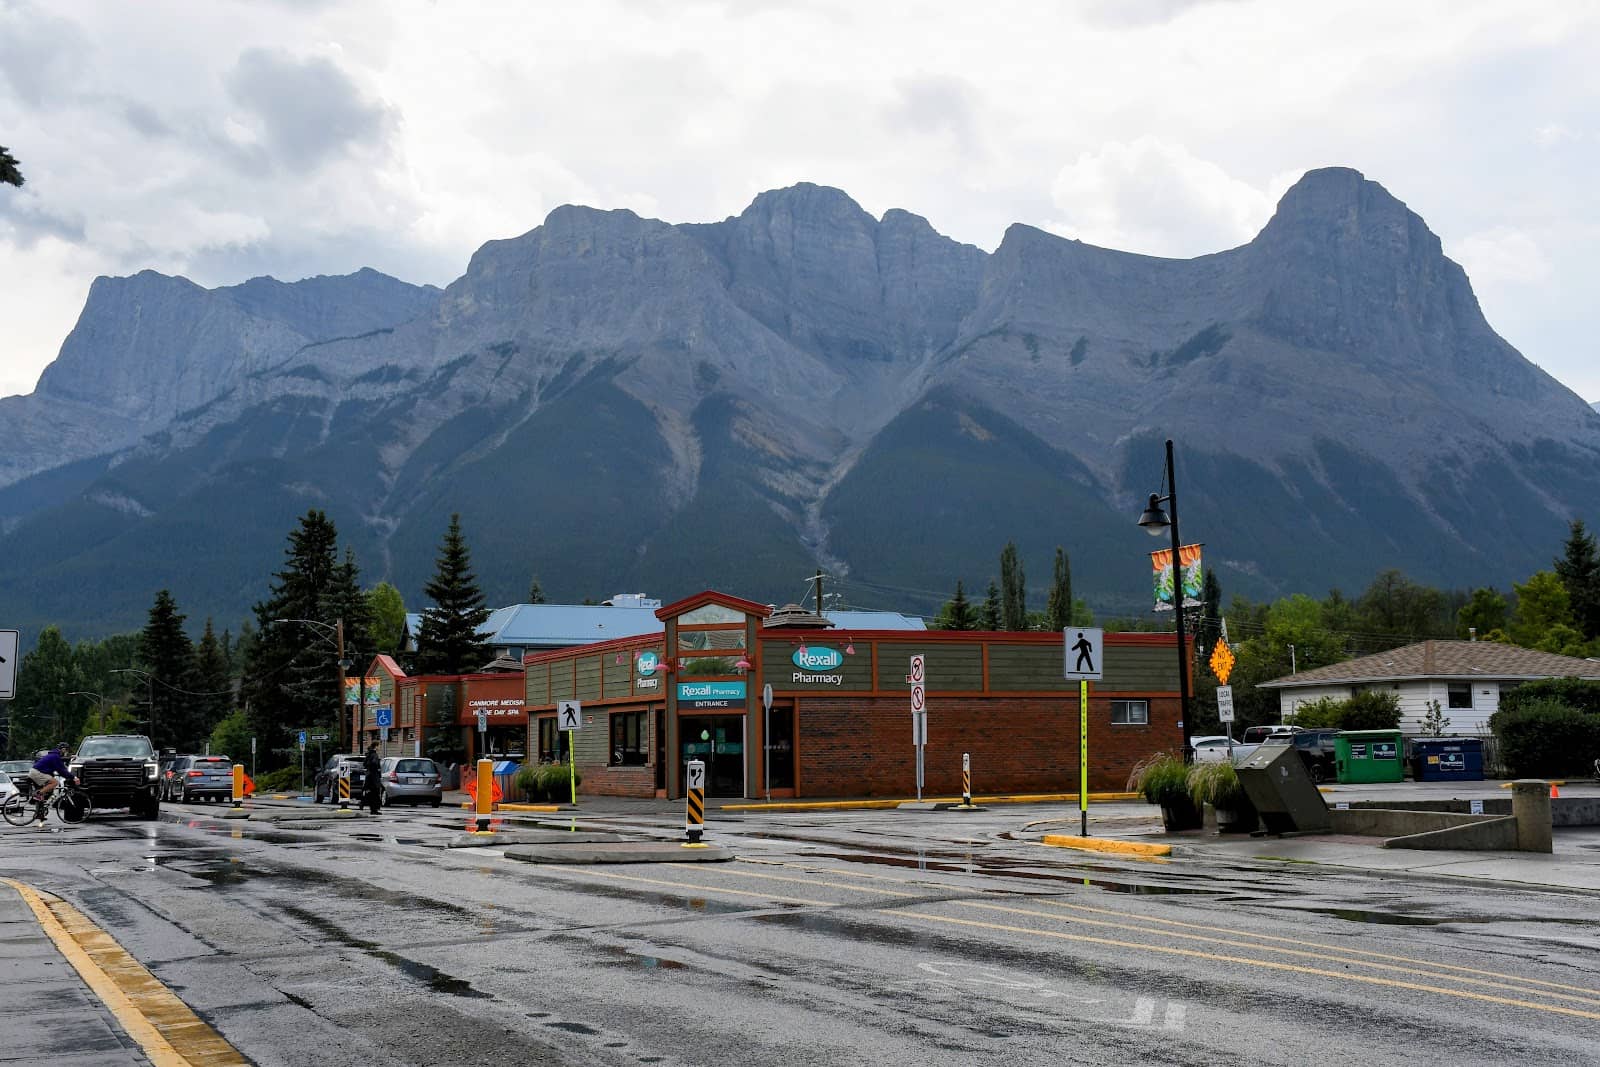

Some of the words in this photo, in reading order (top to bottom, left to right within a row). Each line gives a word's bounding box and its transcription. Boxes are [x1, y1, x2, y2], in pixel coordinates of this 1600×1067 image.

[799, 651, 837, 667] Rexall
[1217, 651, 1226, 660] NO
[638, 656, 656, 673] Rexall
[637, 677, 659, 689] Pharmacy
[792, 671, 843, 686] Pharmacy
[682, 684, 711, 697] Rexall
[712, 688, 741, 696] Pharmacy
